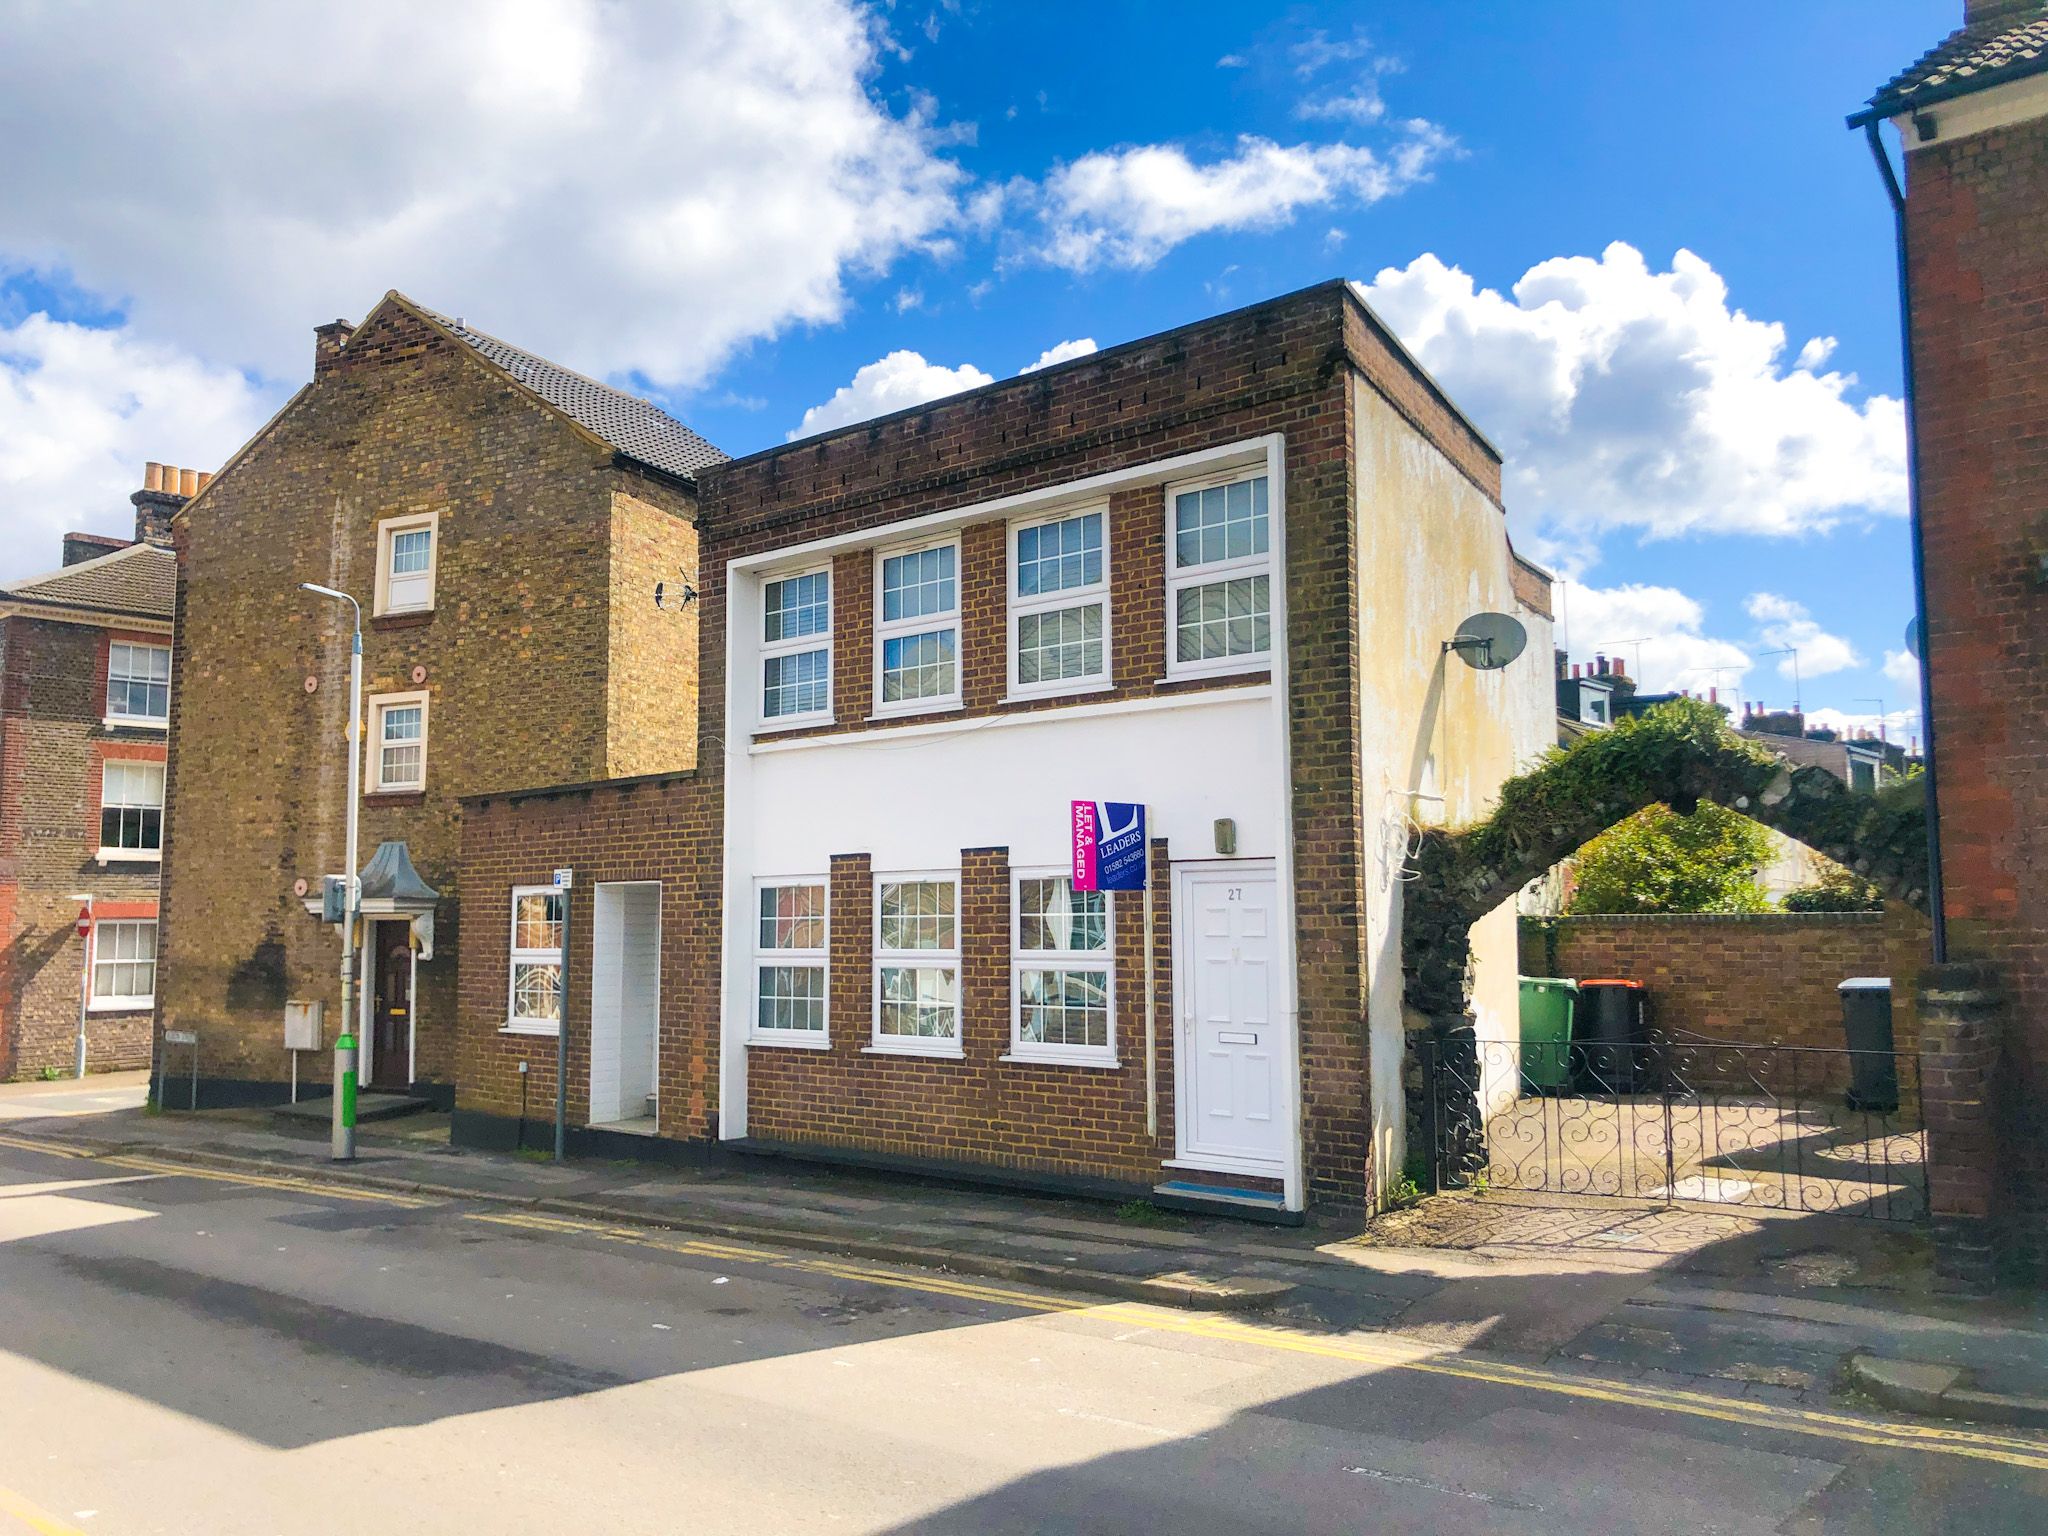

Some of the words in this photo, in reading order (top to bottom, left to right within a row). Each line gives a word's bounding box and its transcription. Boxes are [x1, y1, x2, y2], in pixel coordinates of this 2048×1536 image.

[1083, 806, 1093, 832] LET
[1075, 805, 1086, 879] MANAGED
[1084, 836, 1093, 846] &
[1100, 831, 1142, 859] LEADERS
[1104, 858, 1123, 875] 01582
[1228, 888, 1242, 901] 27
